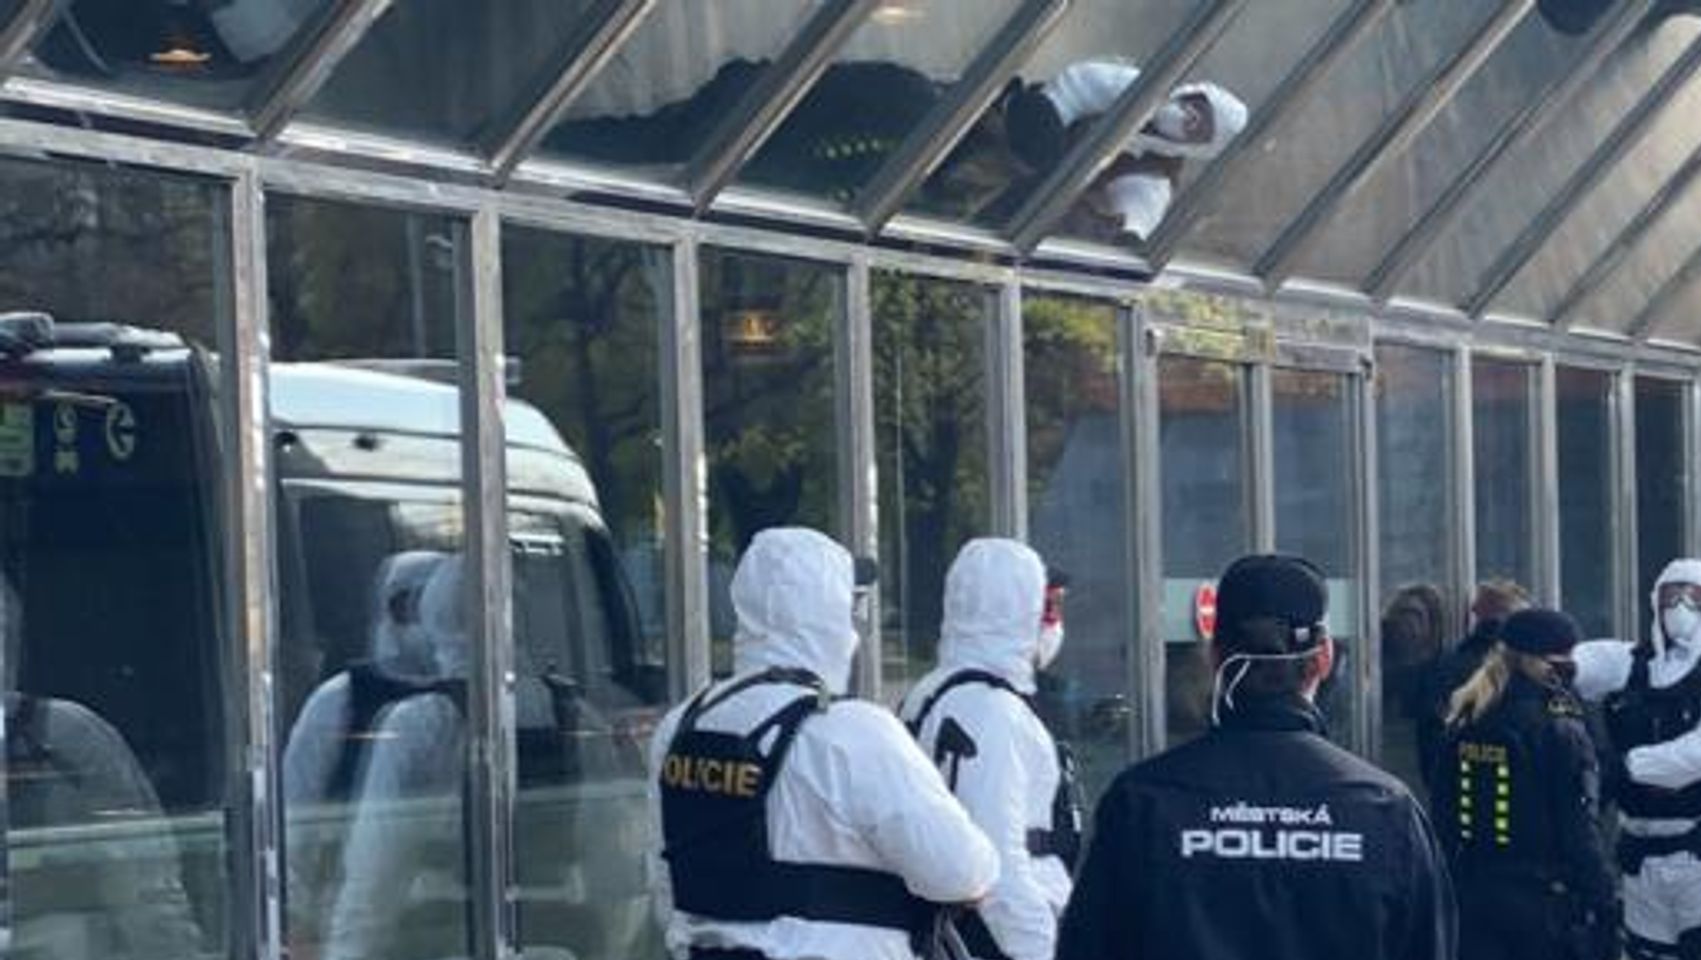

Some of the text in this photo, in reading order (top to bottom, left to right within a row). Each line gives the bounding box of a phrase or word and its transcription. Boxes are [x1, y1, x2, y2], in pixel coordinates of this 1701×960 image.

[663, 754, 763, 796] OLICIE
[1210, 801, 1333, 825] MĚSTSKÁ
[1181, 829, 1363, 861] POLICIE
